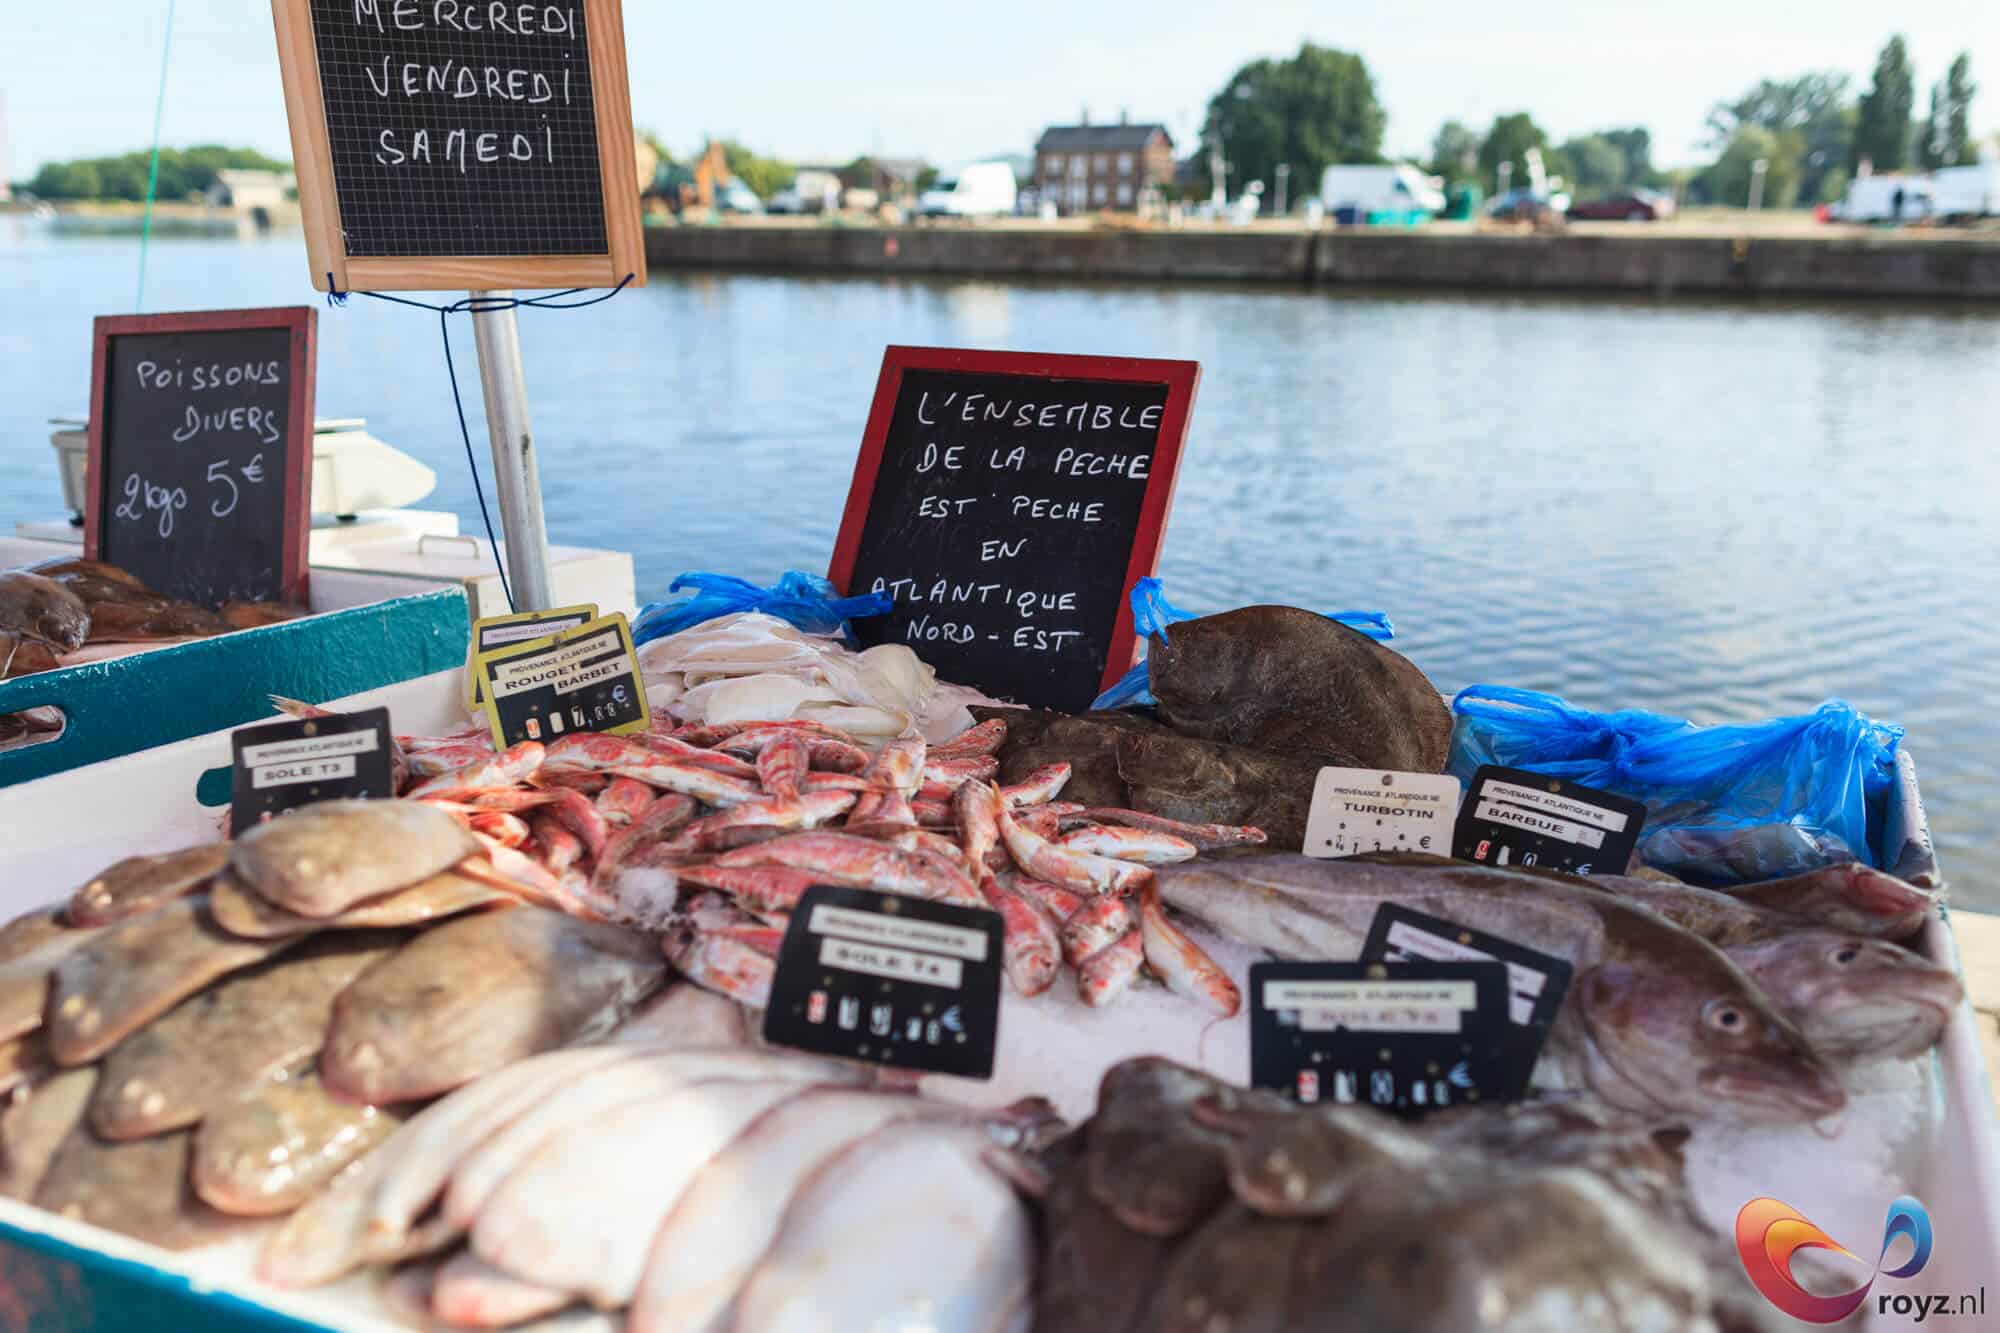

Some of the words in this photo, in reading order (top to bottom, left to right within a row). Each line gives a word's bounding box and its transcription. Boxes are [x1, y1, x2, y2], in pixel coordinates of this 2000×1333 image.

[354, 0, 576, 40] MERCREDI
[365, 53, 571, 105] VENDREDI
[375, 113, 553, 174] SAMEDI
[136, 359, 280, 390] POISSONS
[173, 405, 280, 443] DIVERS
[918, 391, 1163, 432] L'ENSEMBLE
[915, 443, 966, 473] DE
[989, 446, 1026, 471] LA
[1054, 447, 1150, 479] PECHE
[919, 496, 977, 519] EST
[1012, 496, 1104, 522] PECHE
[980, 539, 1028, 561] EN
[871, 577, 1077, 618] ATLANTIQUE
[505, 664, 578, 690] ROUGET
[508, 656, 559, 675] PROVENANCE
[557, 662, 621, 689] BARBET
[264, 765, 313, 781] SOLE
[320, 763, 342, 775] T3
[1334, 787, 1381, 797] PROVENANCE
[1492, 786, 1540, 803] PROVENANCE
[1543, 798, 1591, 817] ATLANTIQUE
[1343, 802, 1434, 819] TURBOTIN
[1487, 807, 1566, 834] BARBUE
[836, 947, 902, 969] SOLE
